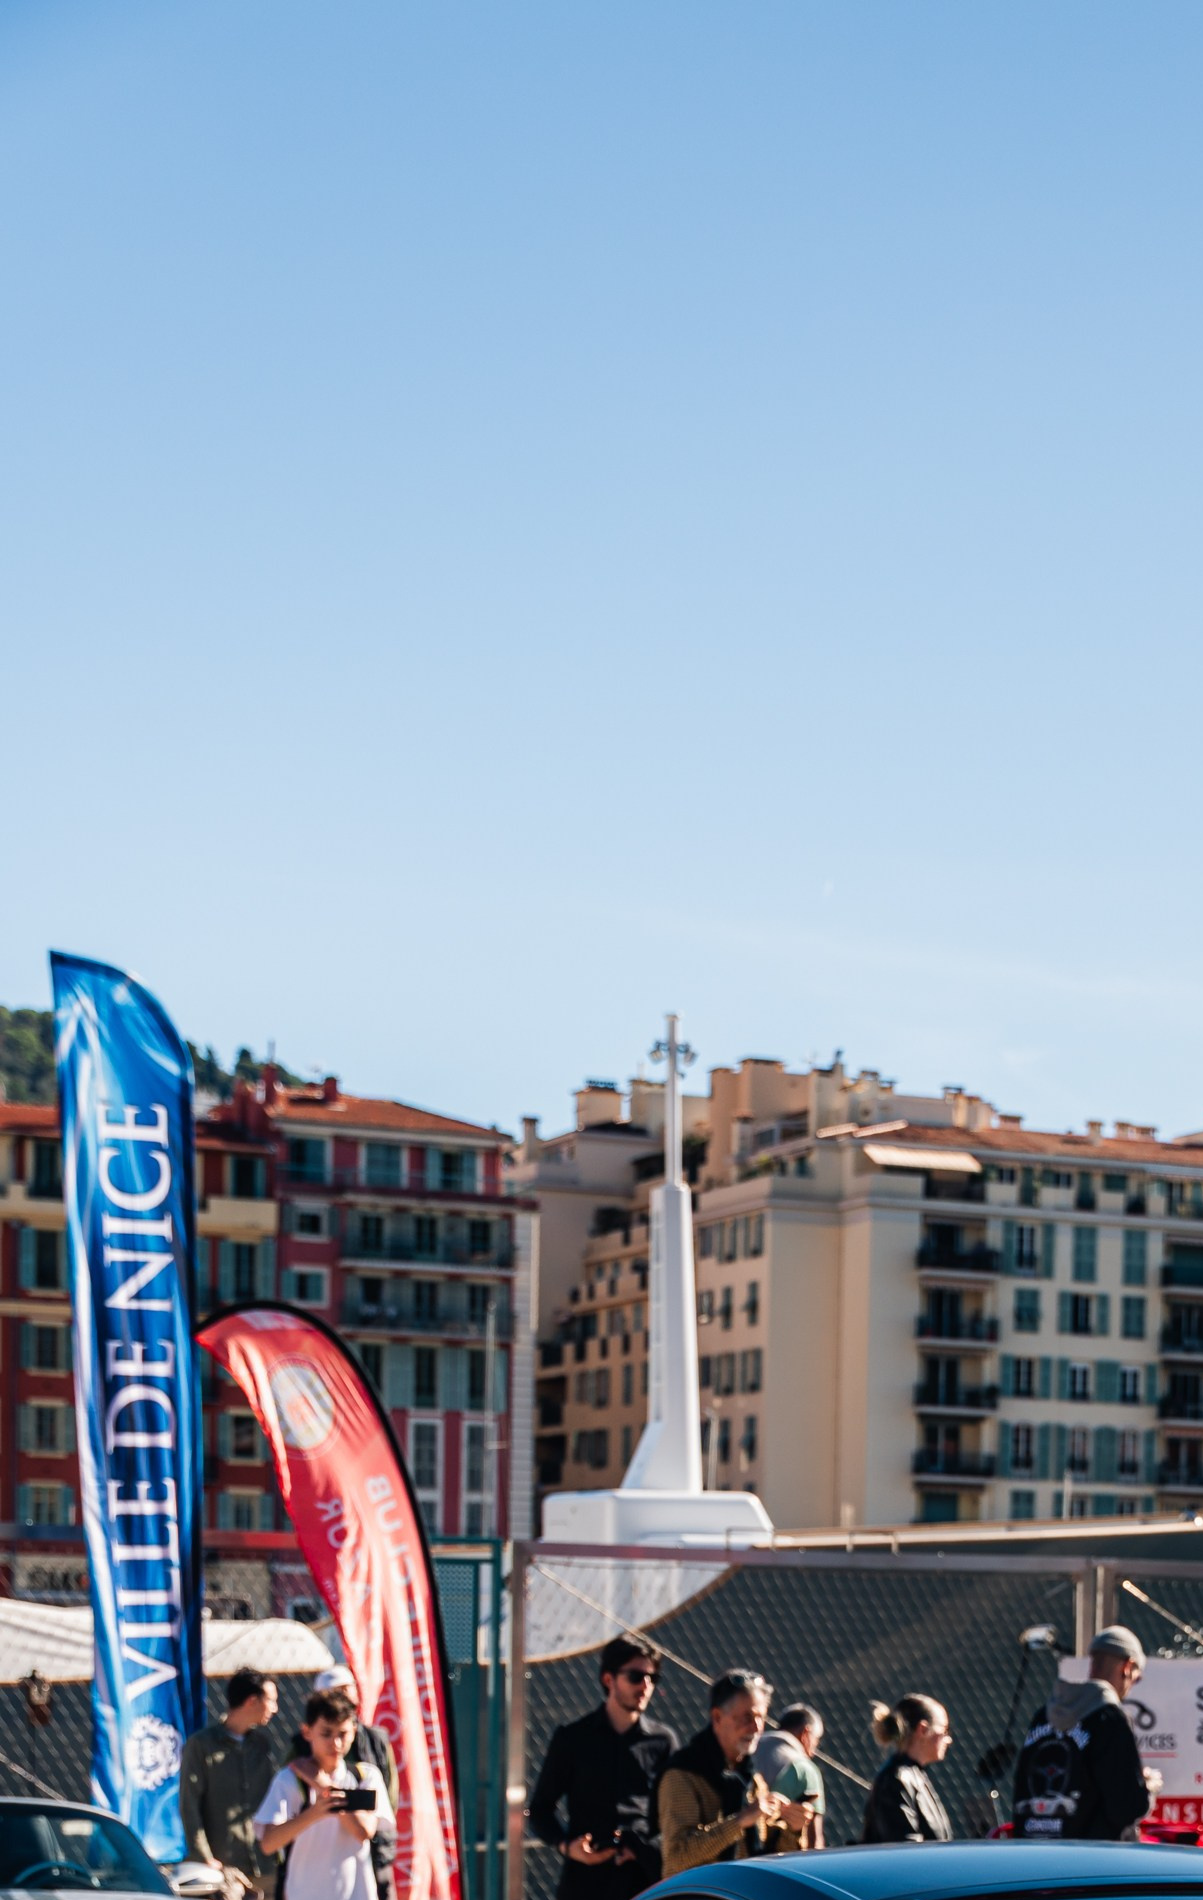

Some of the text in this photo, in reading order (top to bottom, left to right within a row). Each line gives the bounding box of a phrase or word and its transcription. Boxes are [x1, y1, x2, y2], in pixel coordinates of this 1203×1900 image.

[97, 1102, 182, 1701] VILLE DE NICE
